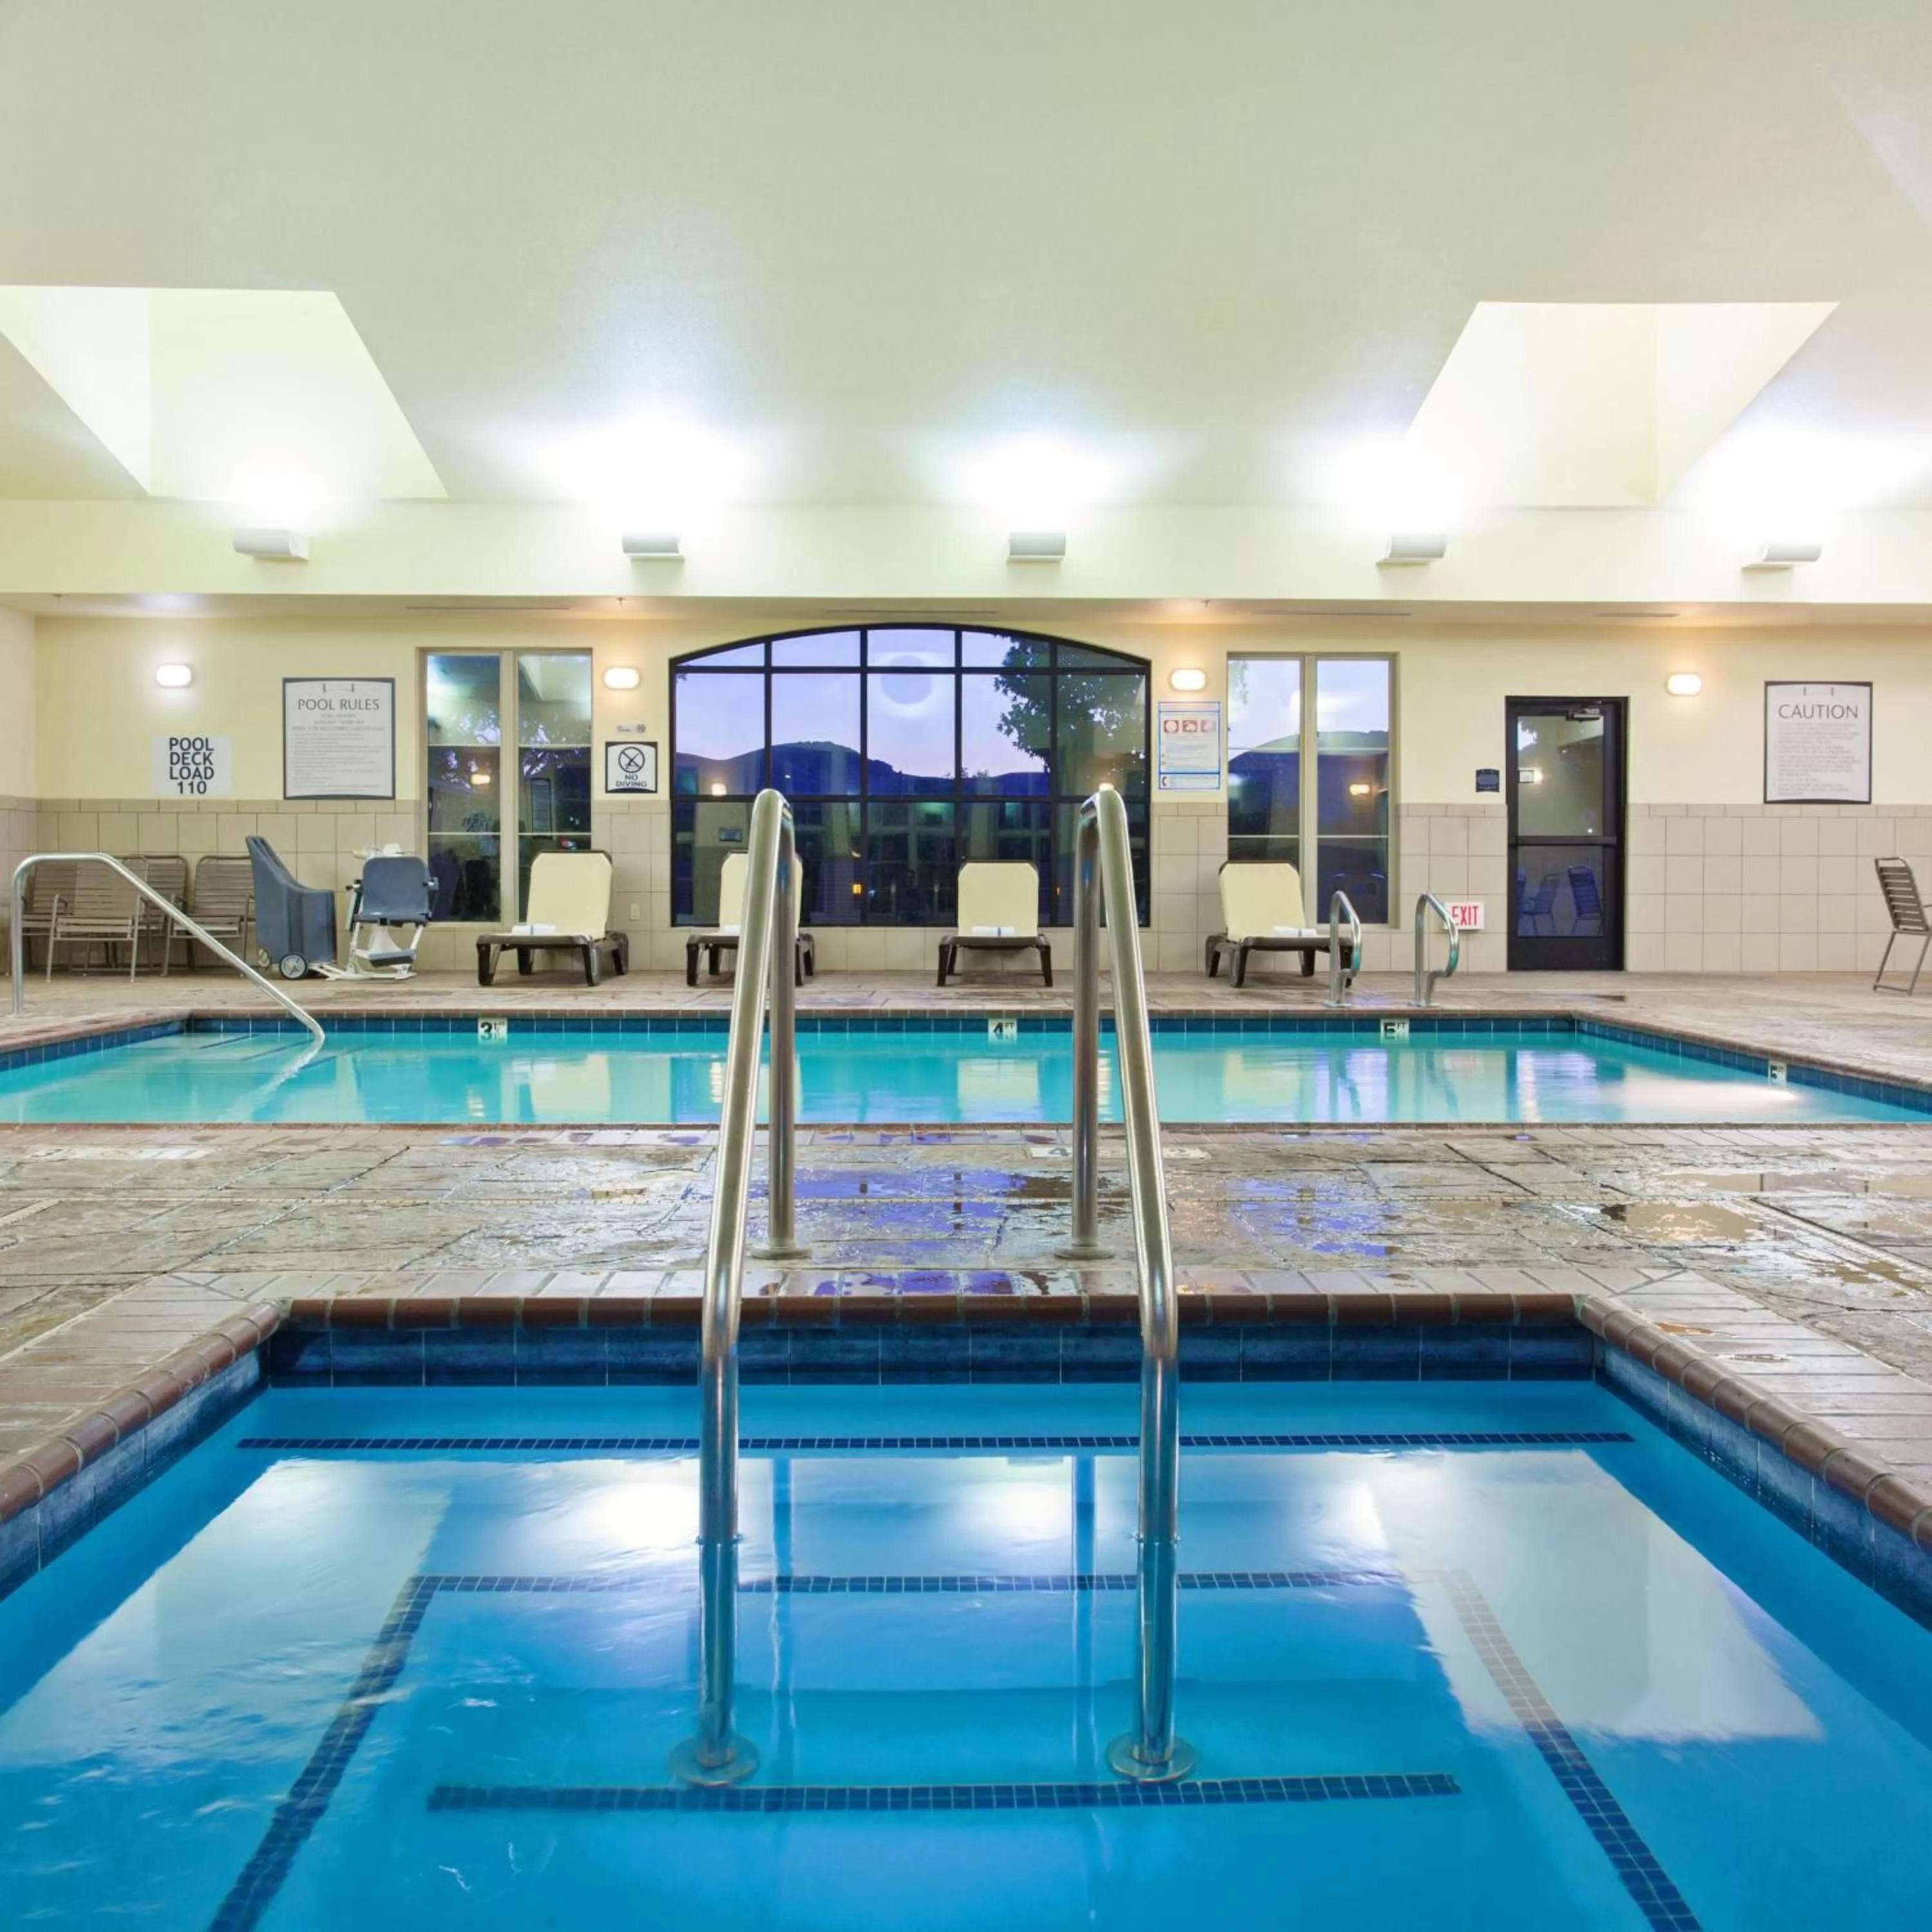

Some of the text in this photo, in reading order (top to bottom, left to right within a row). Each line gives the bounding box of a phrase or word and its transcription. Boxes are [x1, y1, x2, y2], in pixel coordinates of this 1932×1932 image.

[298, 699, 380, 710] POOL RULES
[1778, 704, 1859, 719] CAUTION
[169, 737, 215, 752] POOL
[169, 752, 214, 766] DECK
[169, 766, 214, 780] LOAD
[177, 780, 207, 795] 110
[1451, 905, 1479, 926] EXIT
